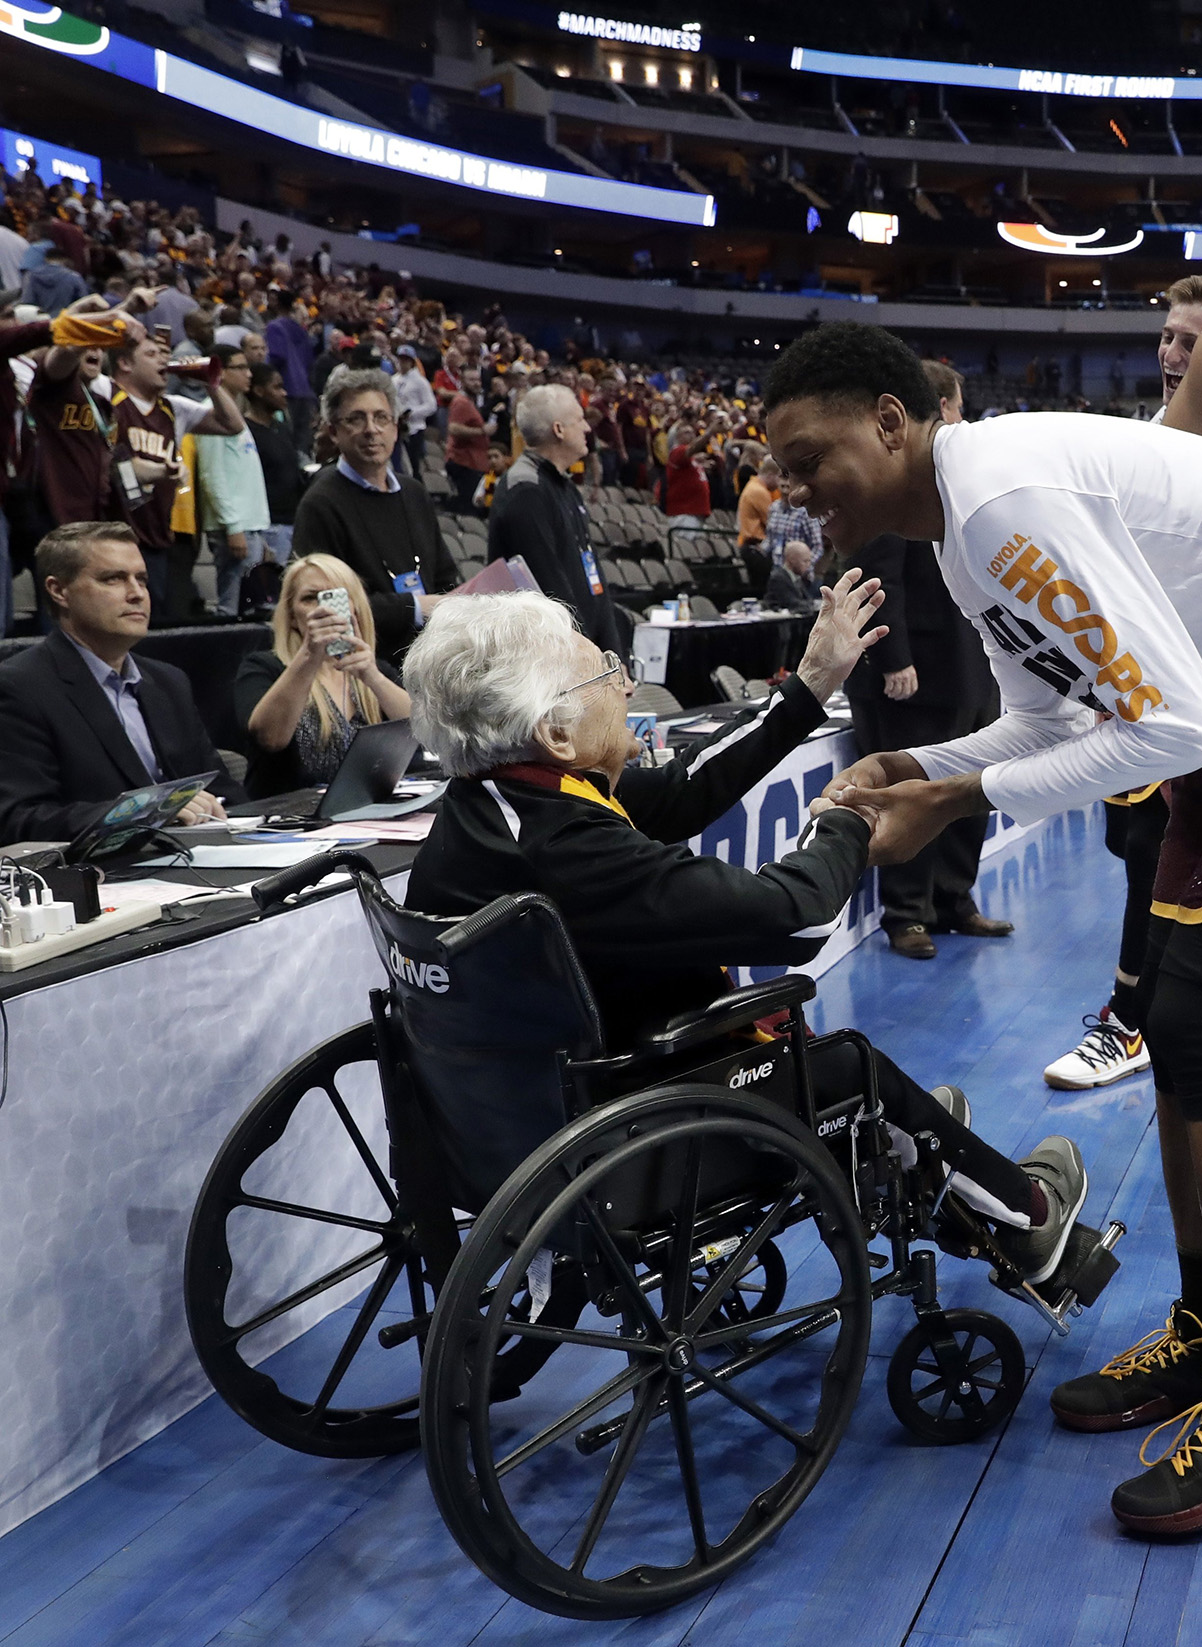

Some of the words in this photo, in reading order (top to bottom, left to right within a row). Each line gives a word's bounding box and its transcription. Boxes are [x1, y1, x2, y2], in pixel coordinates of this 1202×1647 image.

[557, 11, 701, 52] #MARCHMADNESS
[1018, 69, 1063, 94] NCAA
[1064, 74, 1114, 97] FIRST
[1114, 76, 1175, 98] ROUND
[318, 119, 385, 162] LOYOLA
[386, 138, 462, 181] CHICAGO
[463, 157, 487, 186] VS
[986, 533, 1027, 579] LOYOLA
[999, 543, 1163, 723] HOOPS
[390, 941, 450, 993] drive
[729, 1060, 774, 1089] drive
[818, 1116, 847, 1137] drive
